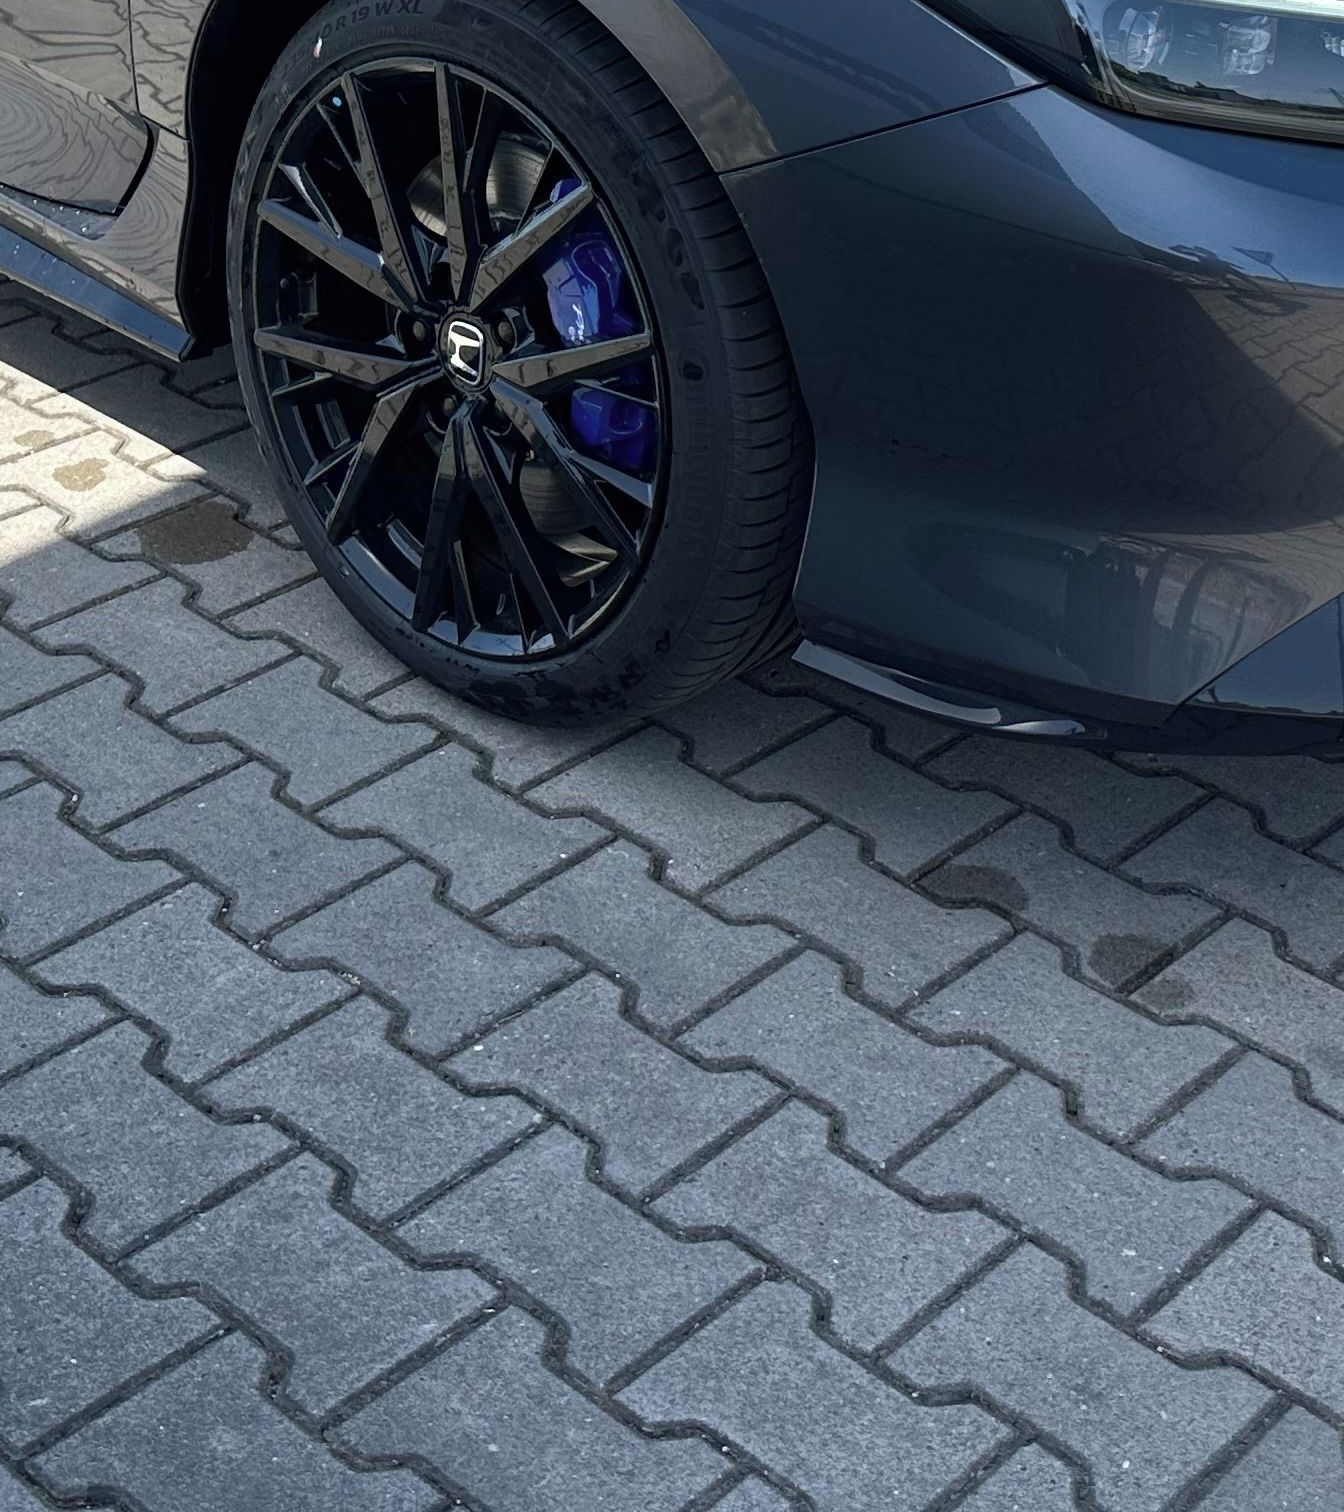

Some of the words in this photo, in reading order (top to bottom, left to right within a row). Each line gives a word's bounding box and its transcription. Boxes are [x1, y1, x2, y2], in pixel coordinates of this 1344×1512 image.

[335, 15, 347, 32] R
[351, 5, 370, 24] 19
[374, 1, 394, 17] W
[396, 0, 424, 16] XL
